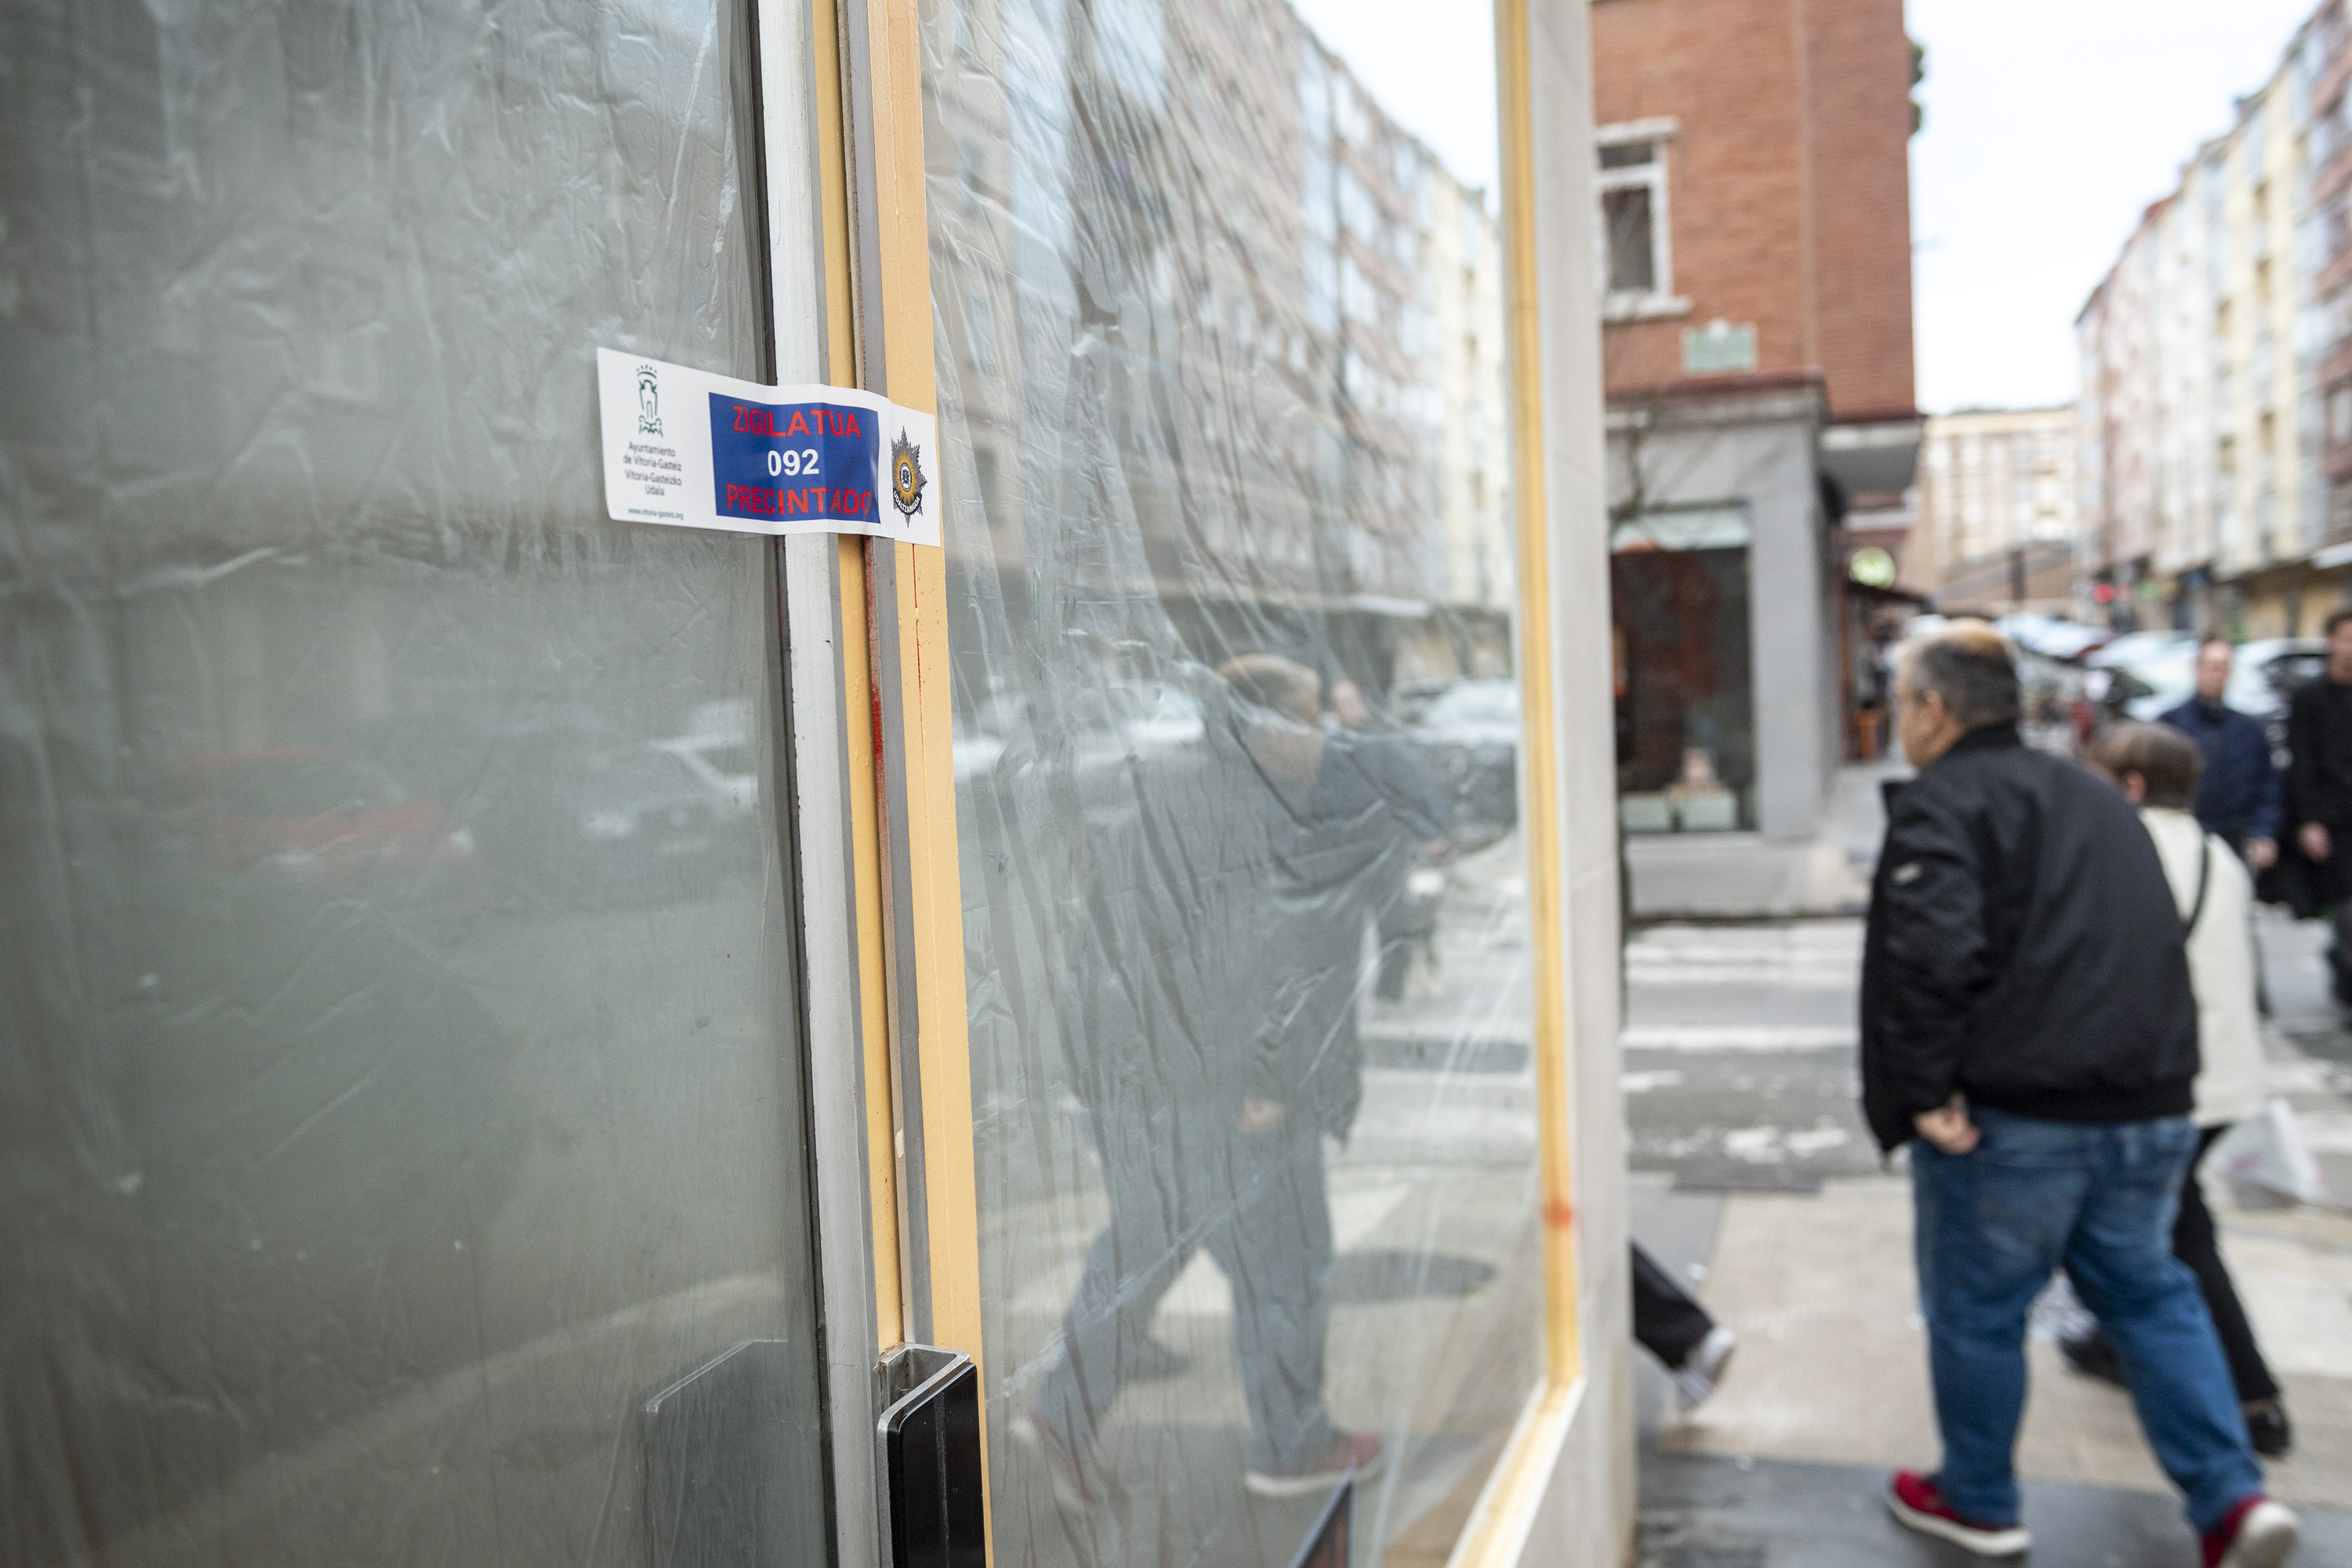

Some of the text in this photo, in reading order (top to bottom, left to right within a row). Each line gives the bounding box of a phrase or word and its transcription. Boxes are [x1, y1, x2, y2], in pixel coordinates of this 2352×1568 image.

[733, 405, 862, 439] ZIGILATUA
[629, 441, 675, 457] Ayuntamiento
[623, 453, 681, 471] de Vitoria-Gasteiz
[768, 449, 820, 477] 092
[626, 470, 682, 486] Vitoria-Gasteizko
[644, 485, 665, 496] Udala
[727, 484, 872, 516] PRECINTADO
